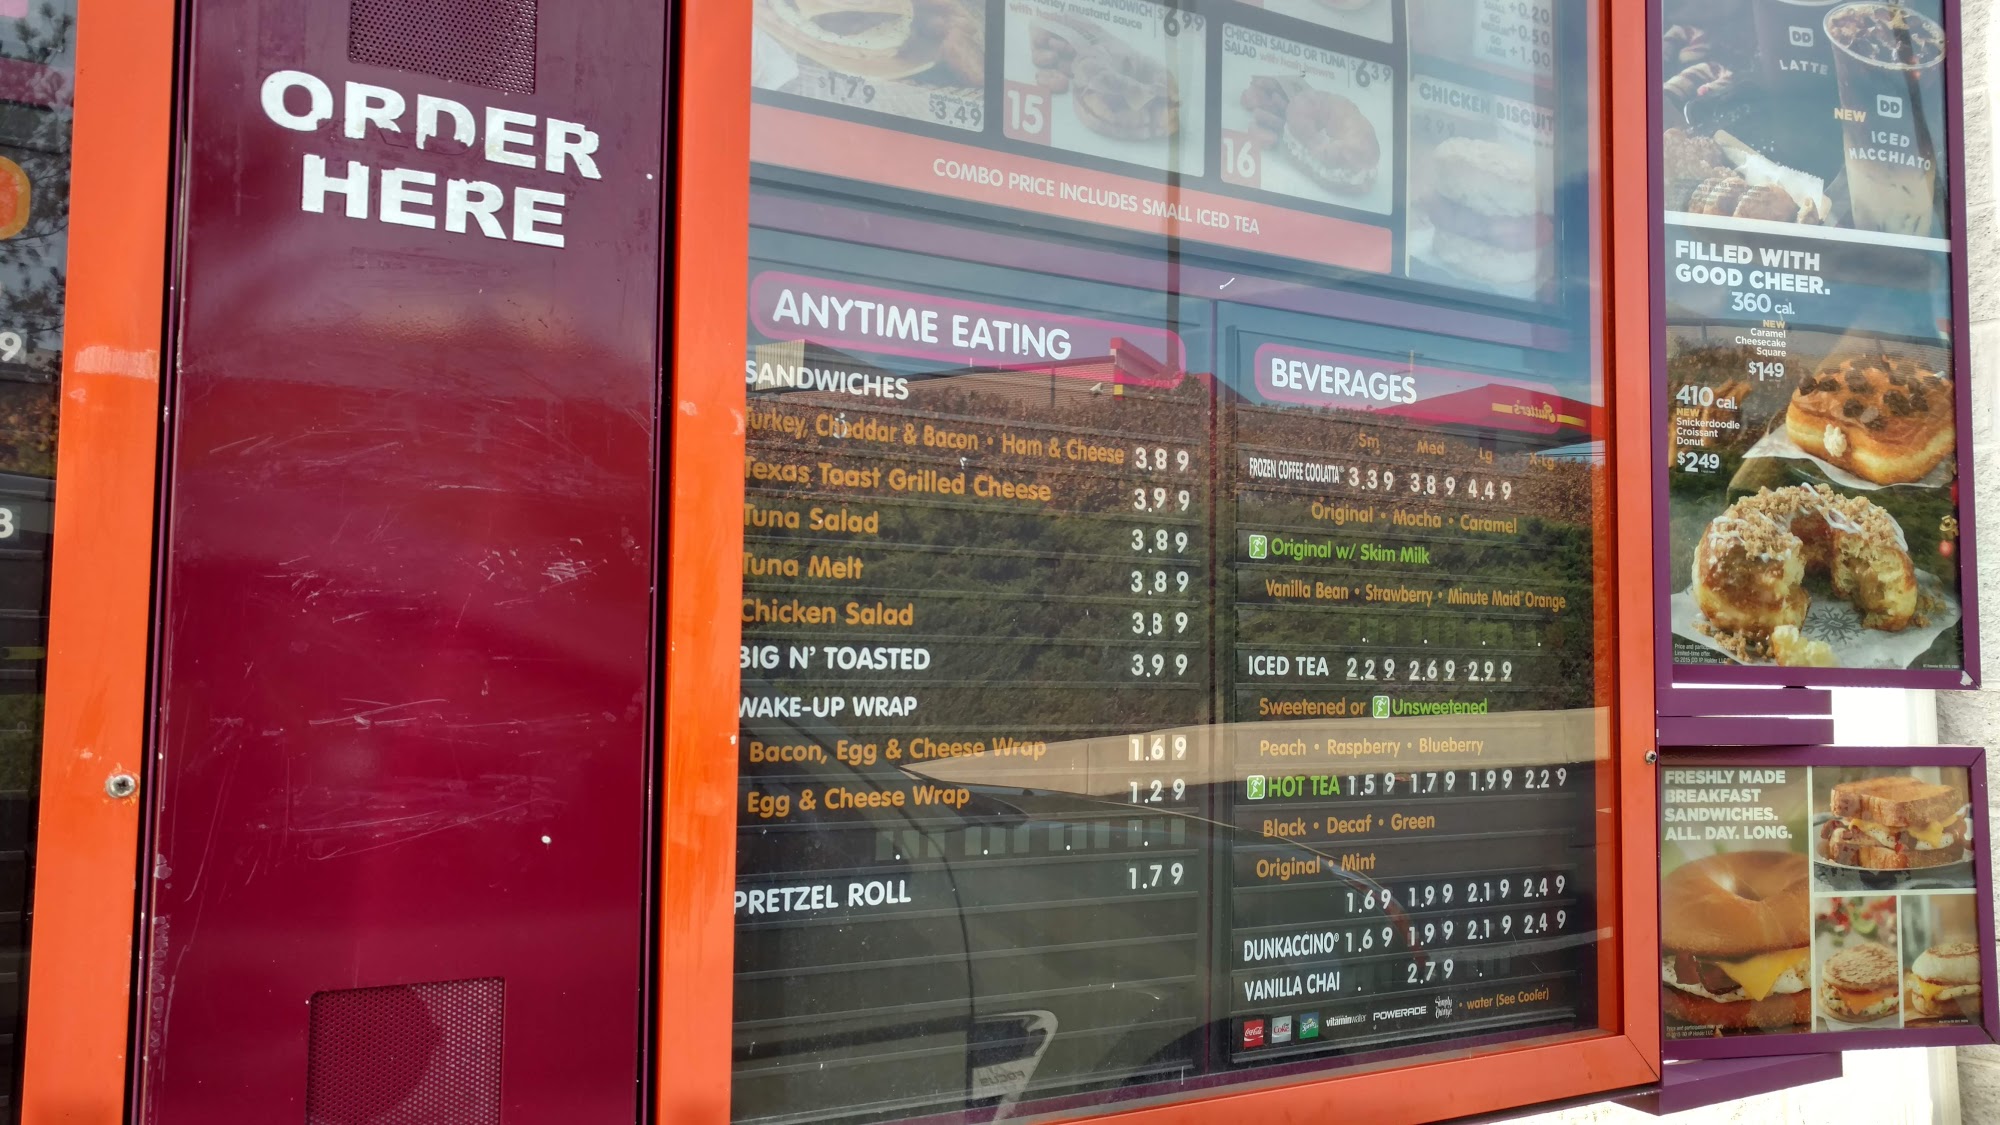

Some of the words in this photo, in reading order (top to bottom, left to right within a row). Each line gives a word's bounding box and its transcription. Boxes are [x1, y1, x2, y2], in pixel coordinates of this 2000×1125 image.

[1069, 4, 1110, 23] mustard
[1113, 15, 1143, 30] sauce
[1224, 25, 1268, 48] CHICKEN
[1270, 38, 1301, 57] SALAD
[1303, 47, 1318, 62] OR
[1320, 52, 1346, 69] TUNA
[1224, 39, 1257, 59] SALAD
[1778, 59, 1829, 76] LATTE
[1007, 89, 1045, 135] 15
[1419, 82, 1491, 114] CHICKEN
[1496, 102, 1554, 131] BISCUIT
[1833, 107, 1866, 123] NEW
[260, 69, 603, 180] ORDER
[1871, 130, 1910, 148] ICED
[1223, 138, 1257, 178] 16
[301, 152, 566, 249] HERE
[933, 158, 1003, 187] COMBO
[1009, 172, 1055, 198] PRICE
[1060, 182, 1138, 213] INCLUDES
[1143, 199, 1192, 224] SMALL
[1197, 208, 1230, 230] ICED
[1234, 215, 1260, 235] TEA
[1675, 240, 1754, 265] FILLED
[1759, 247, 1821, 272] WITH
[1675, 263, 1743, 287] GOOD
[1749, 270, 1831, 296] CHEER.
[1731, 291, 1772, 313] 360
[1774, 302, 1795, 315] cal.
[772, 288, 939, 344] ANYTIME
[952, 314, 1072, 361] EATING
[1750, 328, 1786, 339] Caramel
[1762, 319, 1786, 329] NEW
[1735, 336, 1787, 348] Cheesecake
[1756, 347, 1787, 358] Square
[746, 360, 910, 401] SANDWICHES
[1271, 357, 1418, 405] BEVERAGES
[1676, 385, 1714, 407] 410
[1716, 397, 1738, 410] cal.
[1676, 408, 1700, 417] NEW
[1676, 417, 1741, 430] Snickerdoodle
[815, 412, 898, 444] Cheddar
[903, 422, 917, 447] &
[923, 425, 978, 450] Bacon
[1002, 432, 1043, 457] Ham
[1049, 437, 1062, 460] &
[1066, 437, 1125, 464] Cheese
[1676, 427, 1718, 438] Croissant
[1676, 436, 1705, 447] Donut
[1416, 439, 1445, 457] Med
[1479, 446, 1494, 465] Lg
[745, 456, 810, 484] Texas
[817, 461, 882, 489] Toast
[888, 467, 966, 495] Grilled
[973, 473, 1052, 502] Cheese
[1249, 457, 1277, 479] FROZEN
[1278, 460, 1304, 481] COFFEE
[744, 502, 800, 530] Tuna
[808, 506, 879, 535] Salad
[1311, 501, 1374, 525] Original
[1392, 507, 1442, 529] Mocha
[1460, 513, 1518, 534] Caramel
[1271, 538, 1332, 562] Original
[1336, 544, 1356, 560] w/
[1360, 543, 1396, 563] Skim
[1399, 545, 1430, 565] Milk
[743, 551, 799, 577] Tuna
[807, 555, 864, 580] Melt
[1265, 578, 1312, 600] Vanilla
[1315, 581, 1349, 600] Bean
[1365, 583, 1433, 607] Strawberry
[1448, 586, 1489, 606] Minute
[1525, 594, 1567, 613] Orange
[741, 598, 837, 625] Chicken
[845, 601, 914, 627] Salad
[740, 645, 780, 670] BIG
[789, 646, 817, 670] N'
[823, 646, 931, 671] TOASTED
[1248, 655, 1291, 677] ICED
[1295, 655, 1329, 677] TEA
[738, 695, 846, 719] WAKE-UP
[852, 695, 918, 718] WRAP
[1259, 697, 1347, 716] Sweetened
[1350, 700, 1367, 715] or
[1392, 697, 1488, 716] Unsweetened
[749, 740, 828, 765] Bacon,
[836, 739, 878, 766] Egg
[885, 737, 902, 760] &
[909, 736, 986, 760] Cheese
[992, 736, 1047, 762] Wrap
[1260, 738, 1307, 757] Peach
[1327, 737, 1401, 759] Raspberry
[1419, 736, 1484, 757] Blueberry
[1268, 777, 1305, 798] HOT
[1310, 774, 1341, 797] TEA
[1665, 770, 1735, 784] FRESHLY
[1739, 770, 1786, 784] MADE
[747, 791, 790, 819] Egg
[798, 788, 818, 812] &
[824, 786, 906, 810] Cheese
[912, 784, 971, 810] Wrap
[1665, 789, 1761, 803] BREAKFAST
[1263, 817, 1307, 838] Black
[1327, 813, 1372, 834] Decaf
[1390, 812, 1436, 833] Green
[1665, 808, 1779, 822] SANDWICHES.
[1665, 827, 1701, 840] ALL.
[1705, 826, 1740, 840] DAY.
[1744, 825, 1793, 840] LONG.
[1256, 854, 1321, 881] Original
[1341, 852, 1377, 873] Mint
[734, 884, 839, 916] PRETZEL
[848, 879, 912, 907] ROLL
[1244, 973, 1303, 1002] VANILLA
[1306, 970, 1341, 993] CHAI
[1466, 996, 1493, 1011] water
[1496, 993, 1516, 1008] (See
[1518, 987, 1550, 1004] Cooler)
[1373, 1005, 1427, 1021] POWERADE
